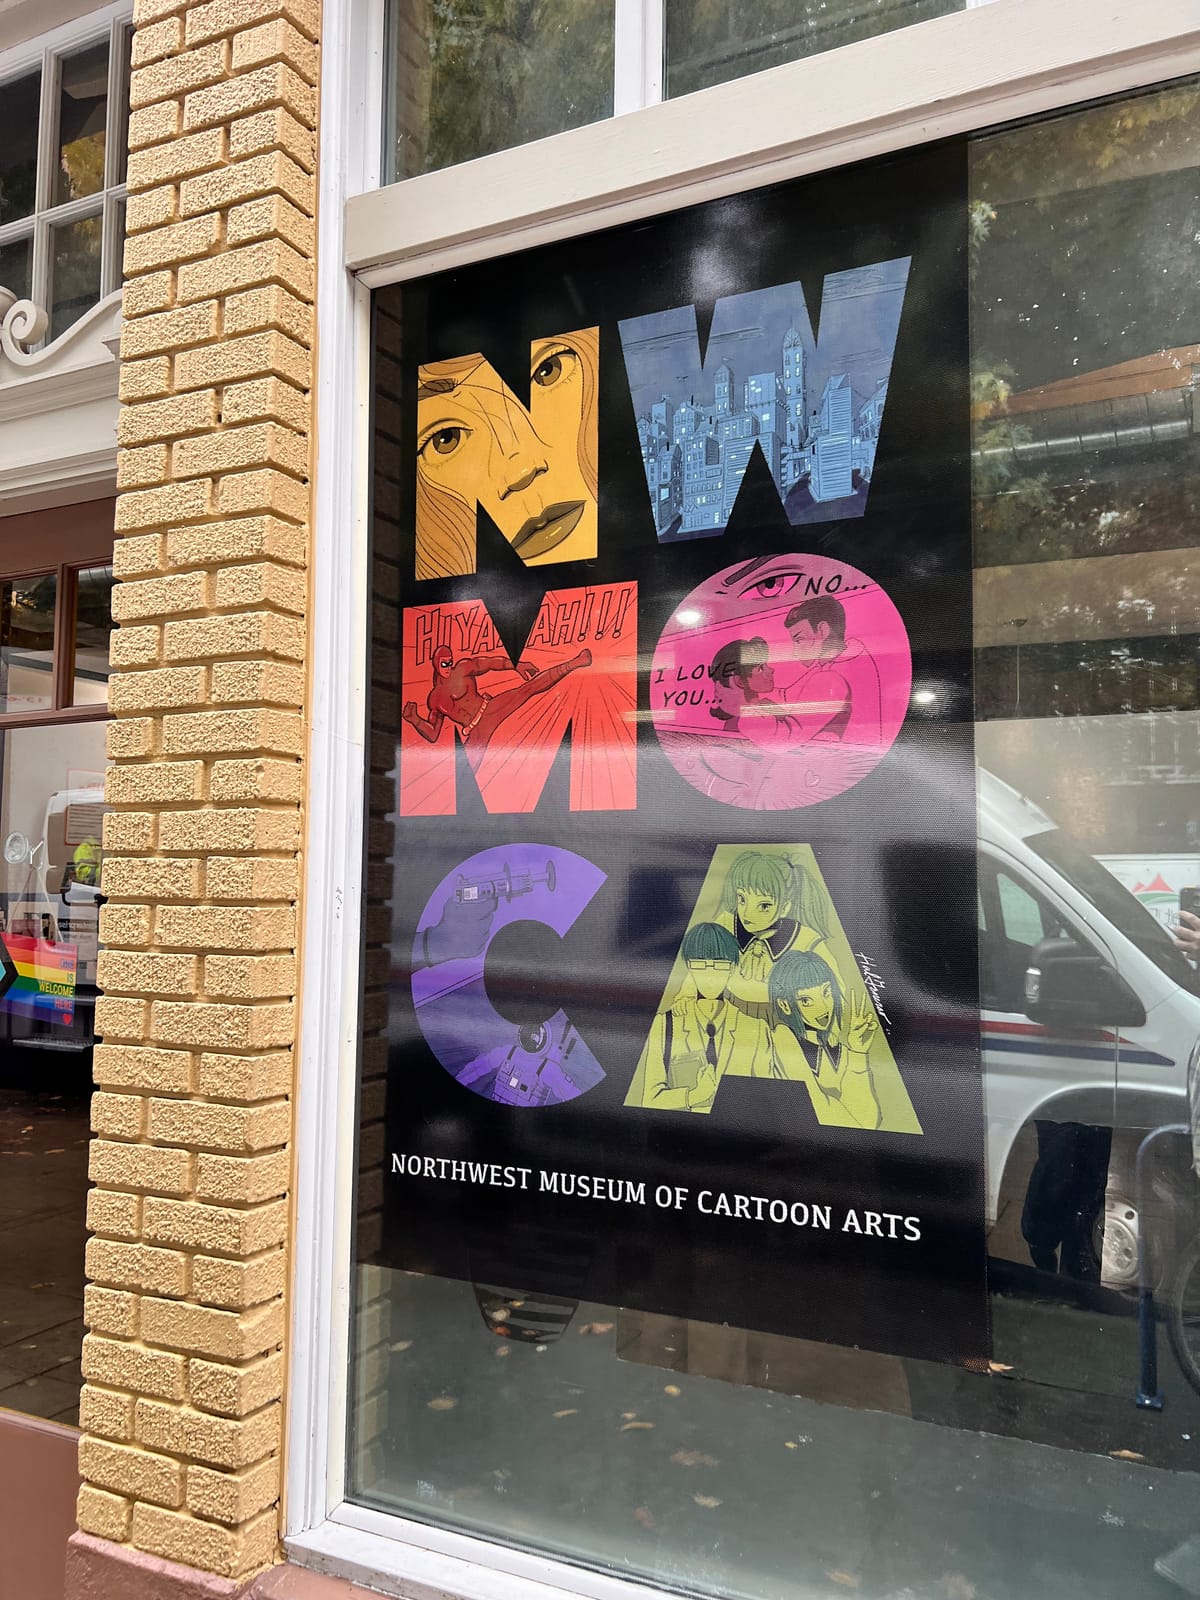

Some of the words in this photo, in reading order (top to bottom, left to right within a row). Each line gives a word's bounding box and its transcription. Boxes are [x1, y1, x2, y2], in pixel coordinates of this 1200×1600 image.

[804, 574, 868, 596] NO...
[654, 668, 667, 684] I
[676, 662, 736, 682] LOVE
[663, 690, 723, 707] YOU...
[39, 981, 73, 997] WELCOME
[54, 999, 73, 1011] HERE
[391, 1153, 532, 1189] NORTHWEST
[539, 1170, 646, 1205] MUSEUM
[655, 1185, 689, 1209] OF
[697, 1190, 832, 1230] CARTOON
[842, 1209, 921, 1241] ARTS
